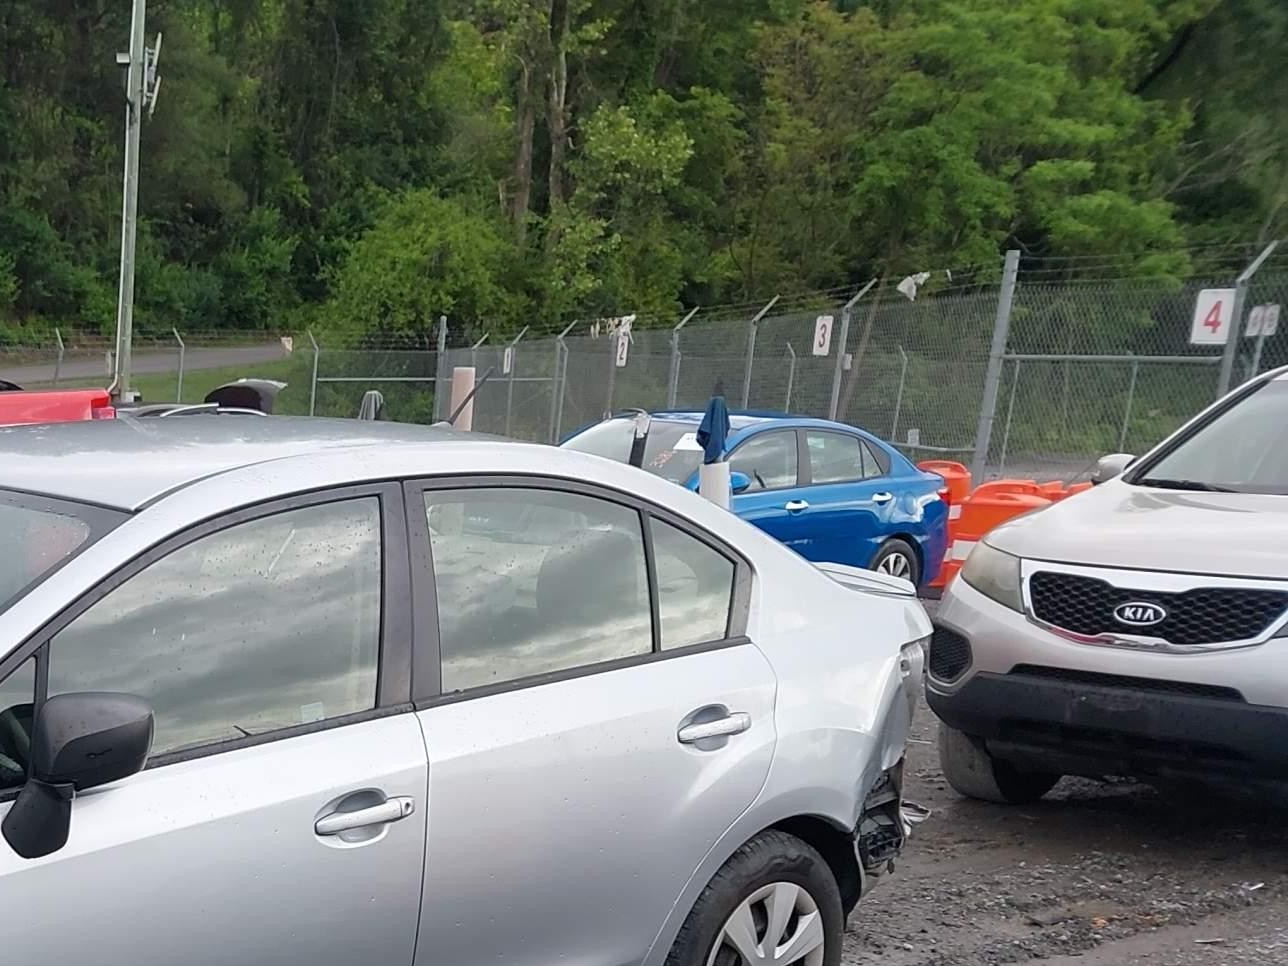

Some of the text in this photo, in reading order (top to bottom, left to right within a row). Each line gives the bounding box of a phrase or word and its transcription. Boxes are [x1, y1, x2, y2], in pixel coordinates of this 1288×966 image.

[1203, 300, 1223, 334] 4
[818, 323, 827, 348] 3
[1124, 606, 1155, 621] KIA
